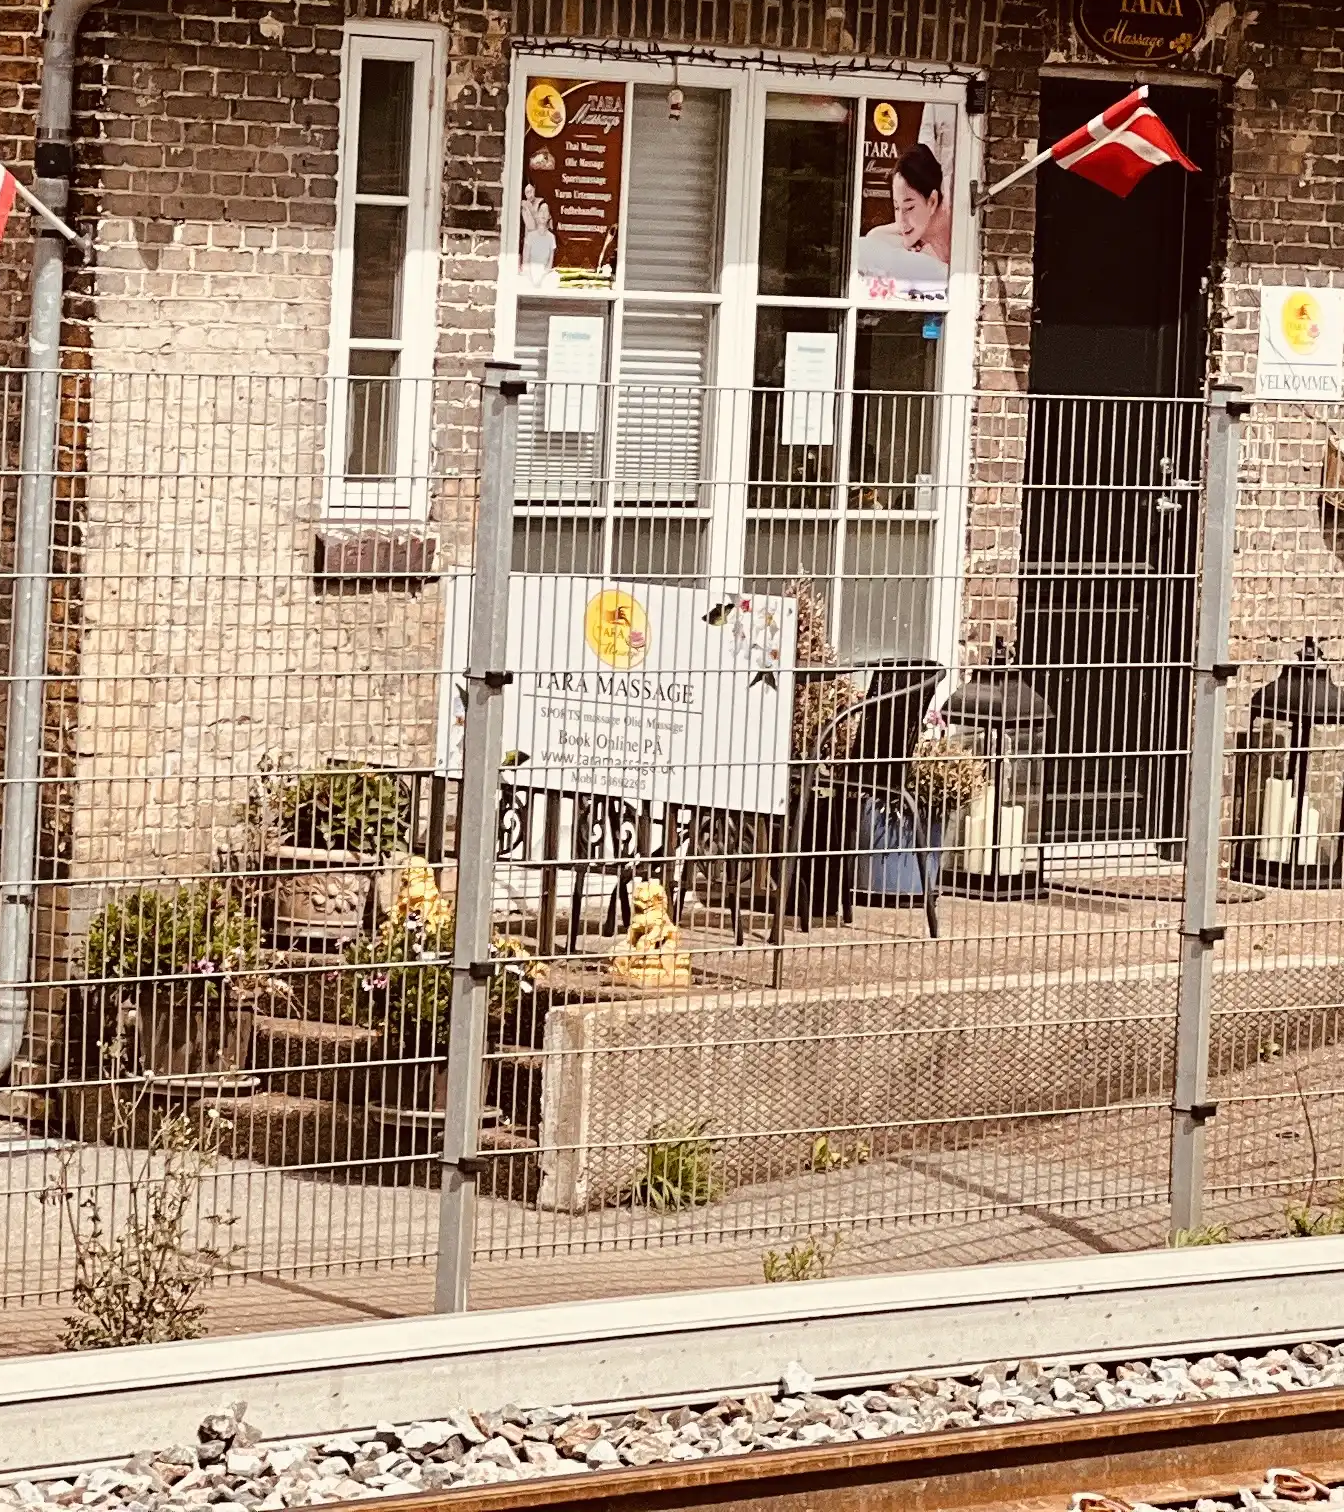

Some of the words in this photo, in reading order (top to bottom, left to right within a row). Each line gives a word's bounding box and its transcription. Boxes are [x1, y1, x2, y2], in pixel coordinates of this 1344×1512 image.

[1103, 19, 1165, 58] Massage
[587, 94, 624, 113] TARA
[863, 140, 898, 159] TARA
[1259, 374, 1338, 393] VELKOMMEN
[535, 671, 589, 694] TARA
[597, 673, 695, 705] MASSAGE
[558, 729, 591, 748] Book
[596, 734, 639, 753] Online
[571, 771, 598, 786] Mobl
